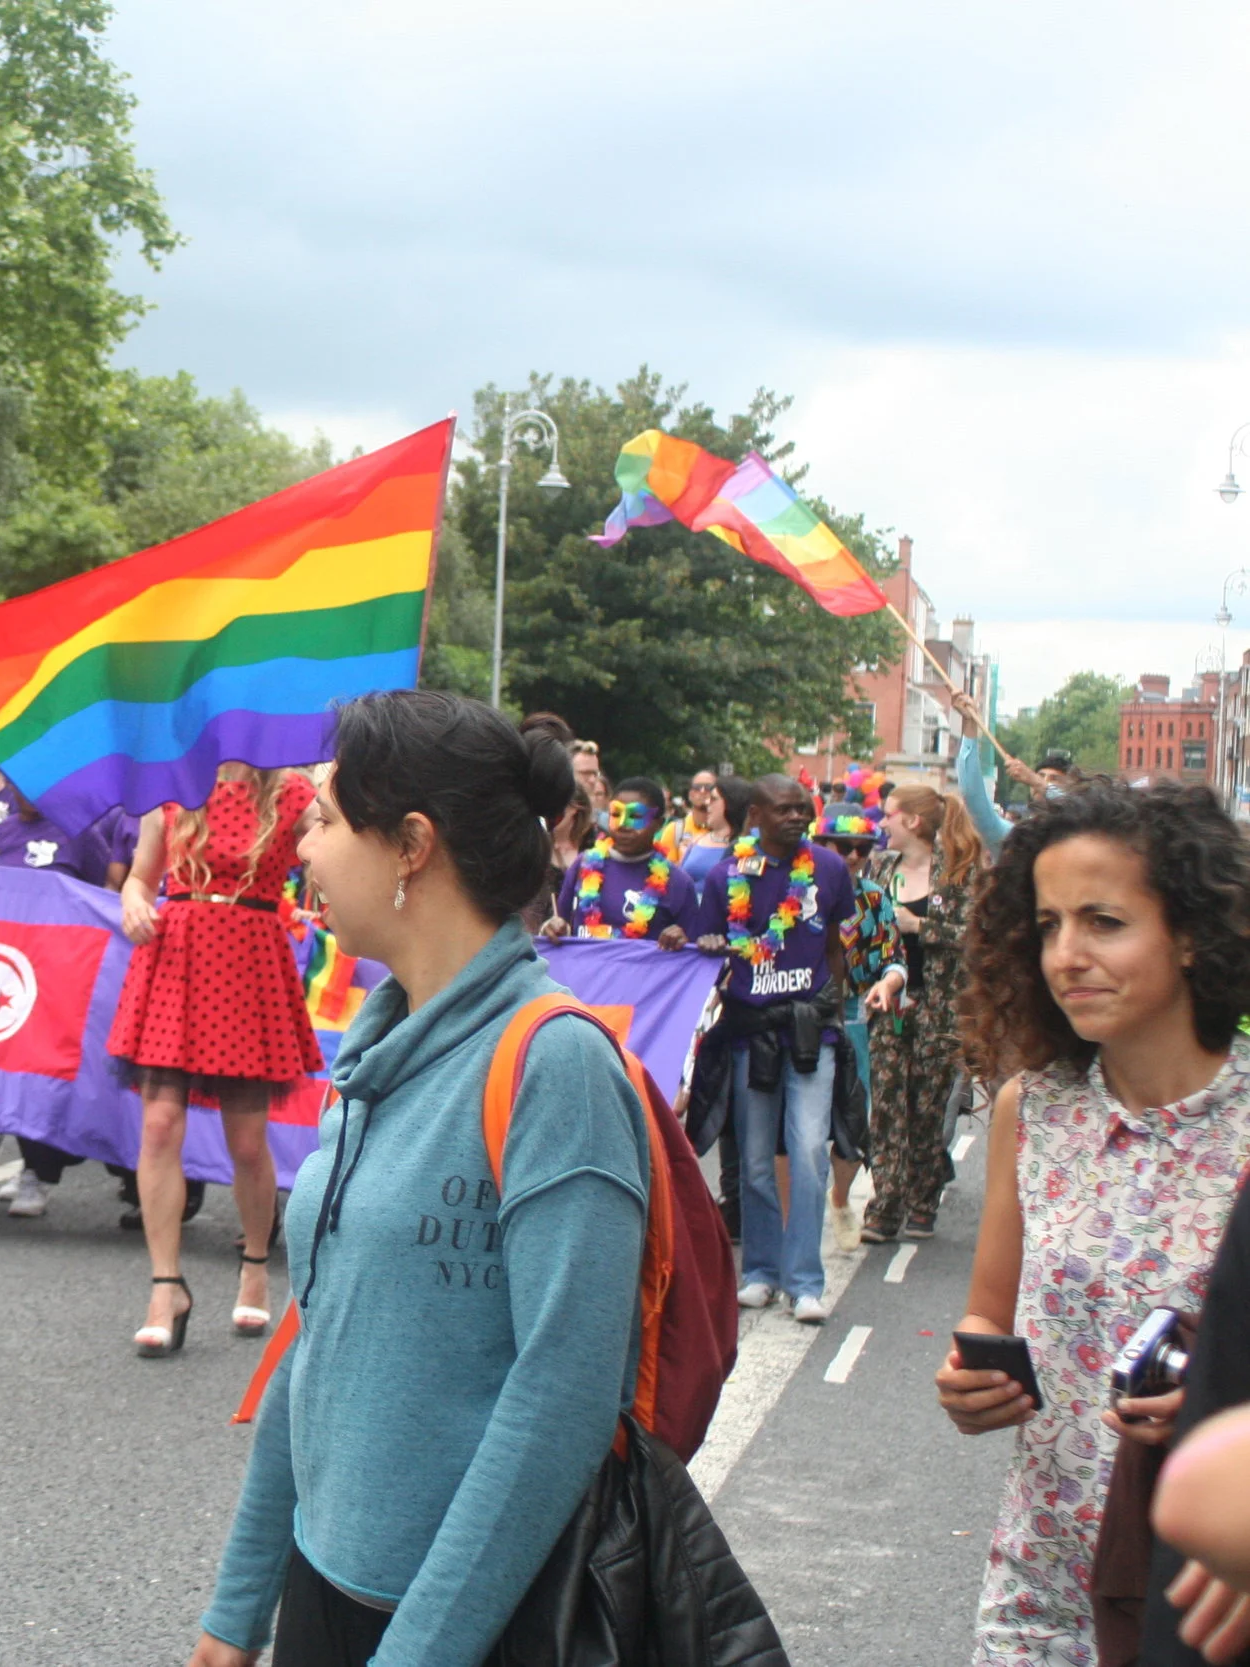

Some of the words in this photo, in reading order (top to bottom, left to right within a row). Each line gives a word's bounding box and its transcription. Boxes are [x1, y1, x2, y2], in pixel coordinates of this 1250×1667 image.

[750, 967, 813, 996] BORDERS
[442, 1175, 496, 1210] OF
[415, 1214, 502, 1253] DUT
[432, 1260, 501, 1290] NYC
